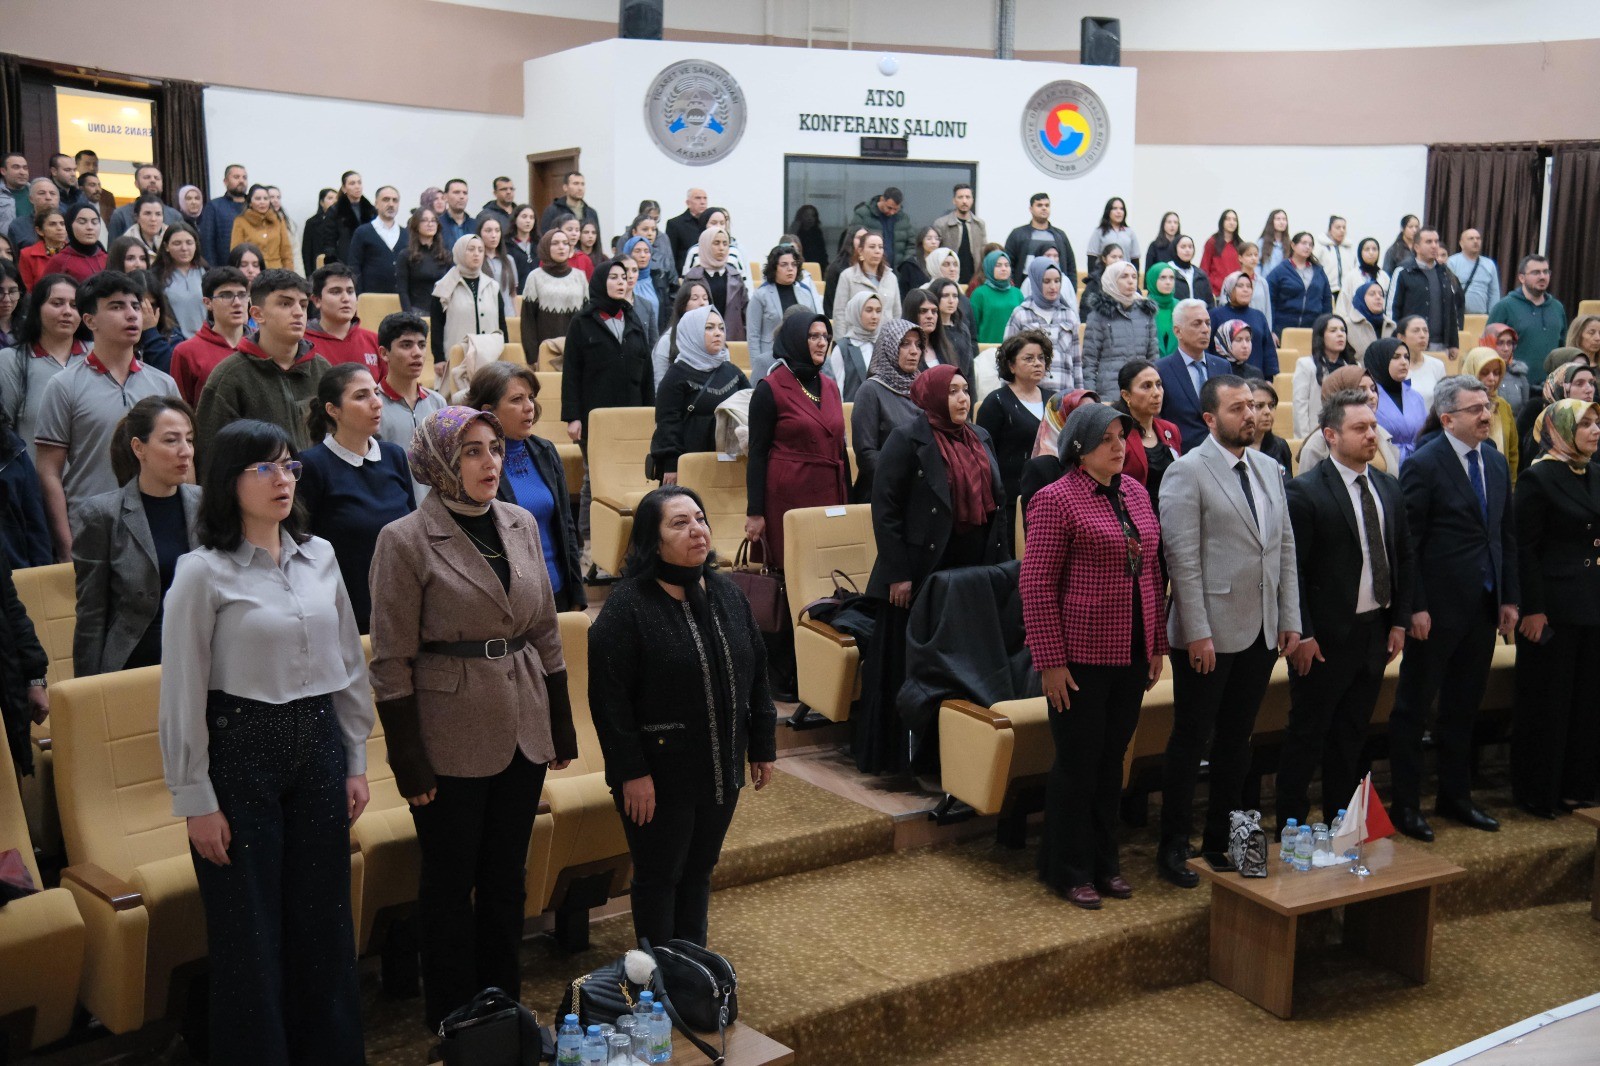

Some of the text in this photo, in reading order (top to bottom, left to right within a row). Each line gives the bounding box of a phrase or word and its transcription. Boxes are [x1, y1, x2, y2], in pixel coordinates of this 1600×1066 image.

[865, 89, 906, 108] ATSO
[799, 113, 968, 138] KONFERANS SALONU
[676, 147, 718, 159] AKSARAY
[1055, 163, 1077, 172] TOBB
